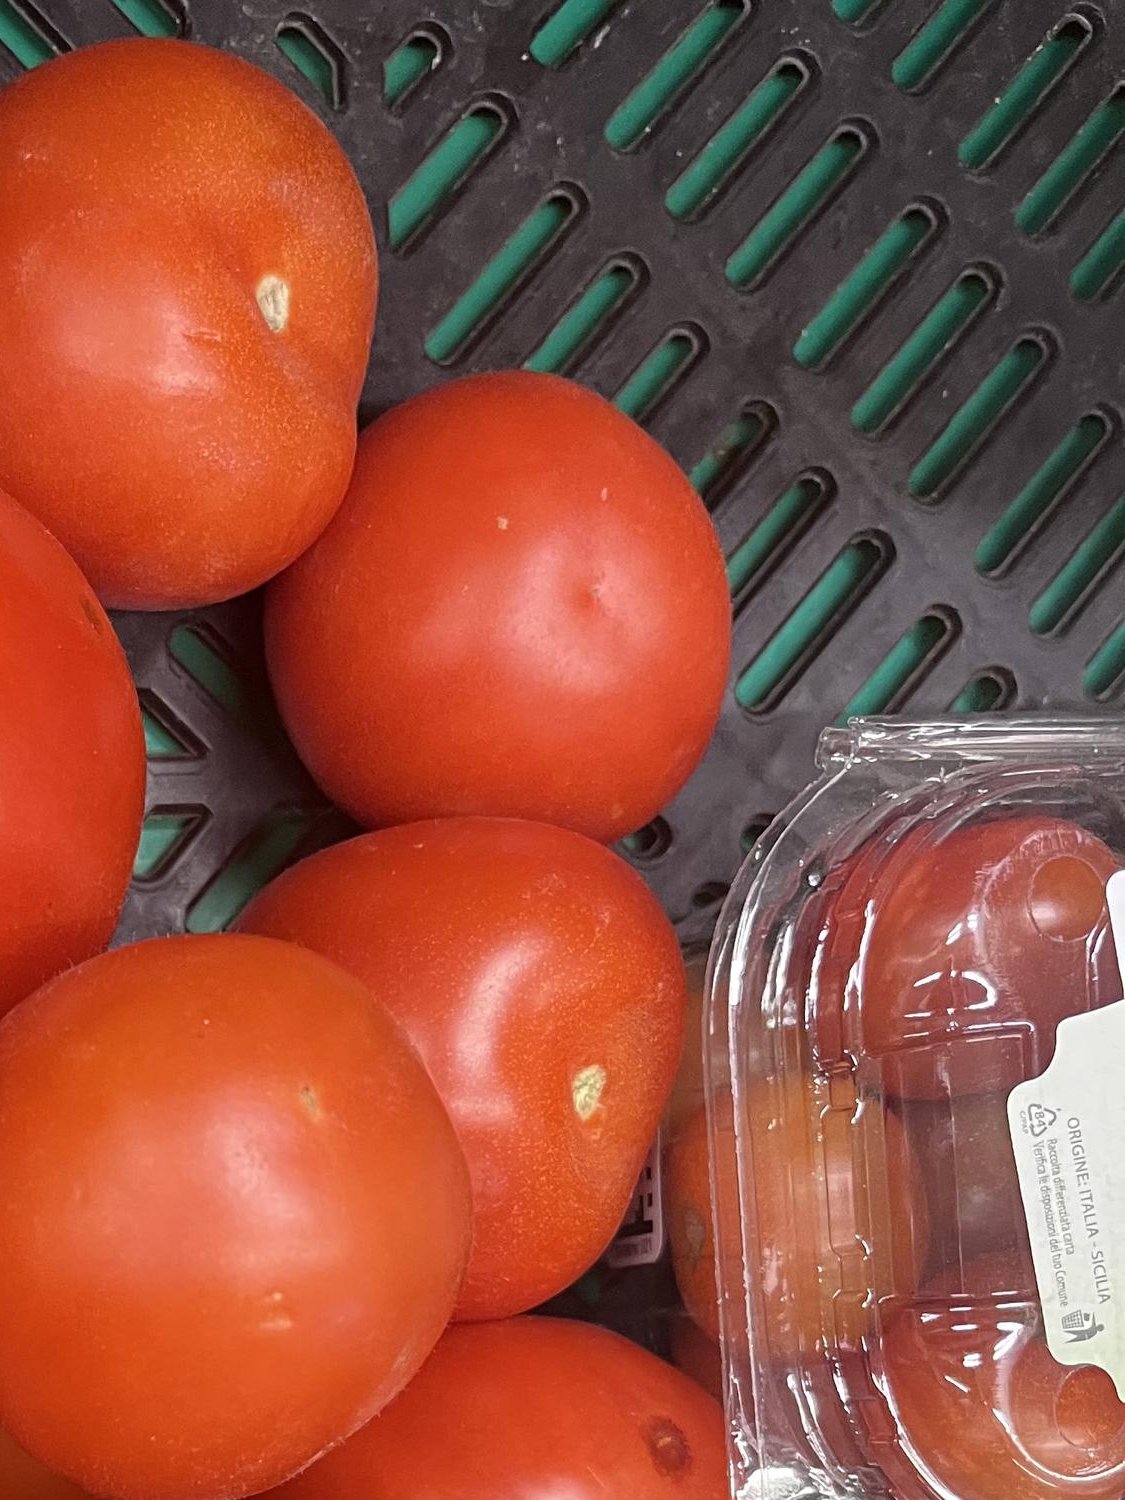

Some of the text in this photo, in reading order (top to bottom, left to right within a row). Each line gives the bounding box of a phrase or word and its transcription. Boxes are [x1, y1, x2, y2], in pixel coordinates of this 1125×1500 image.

[1034, 1111, 1047, 1128] 84
[1033, 1140, 1069, 1307] Verifica le disposizioni del tuo Comune
[1047, 1138, 1075, 1256] Raccolta differenziata carta
[1067, 1117, 1090, 1187] ORIGINE:
[1079, 1189, 1100, 1239] ITALIA
[1091, 1250, 1111, 1305] SICILIA
